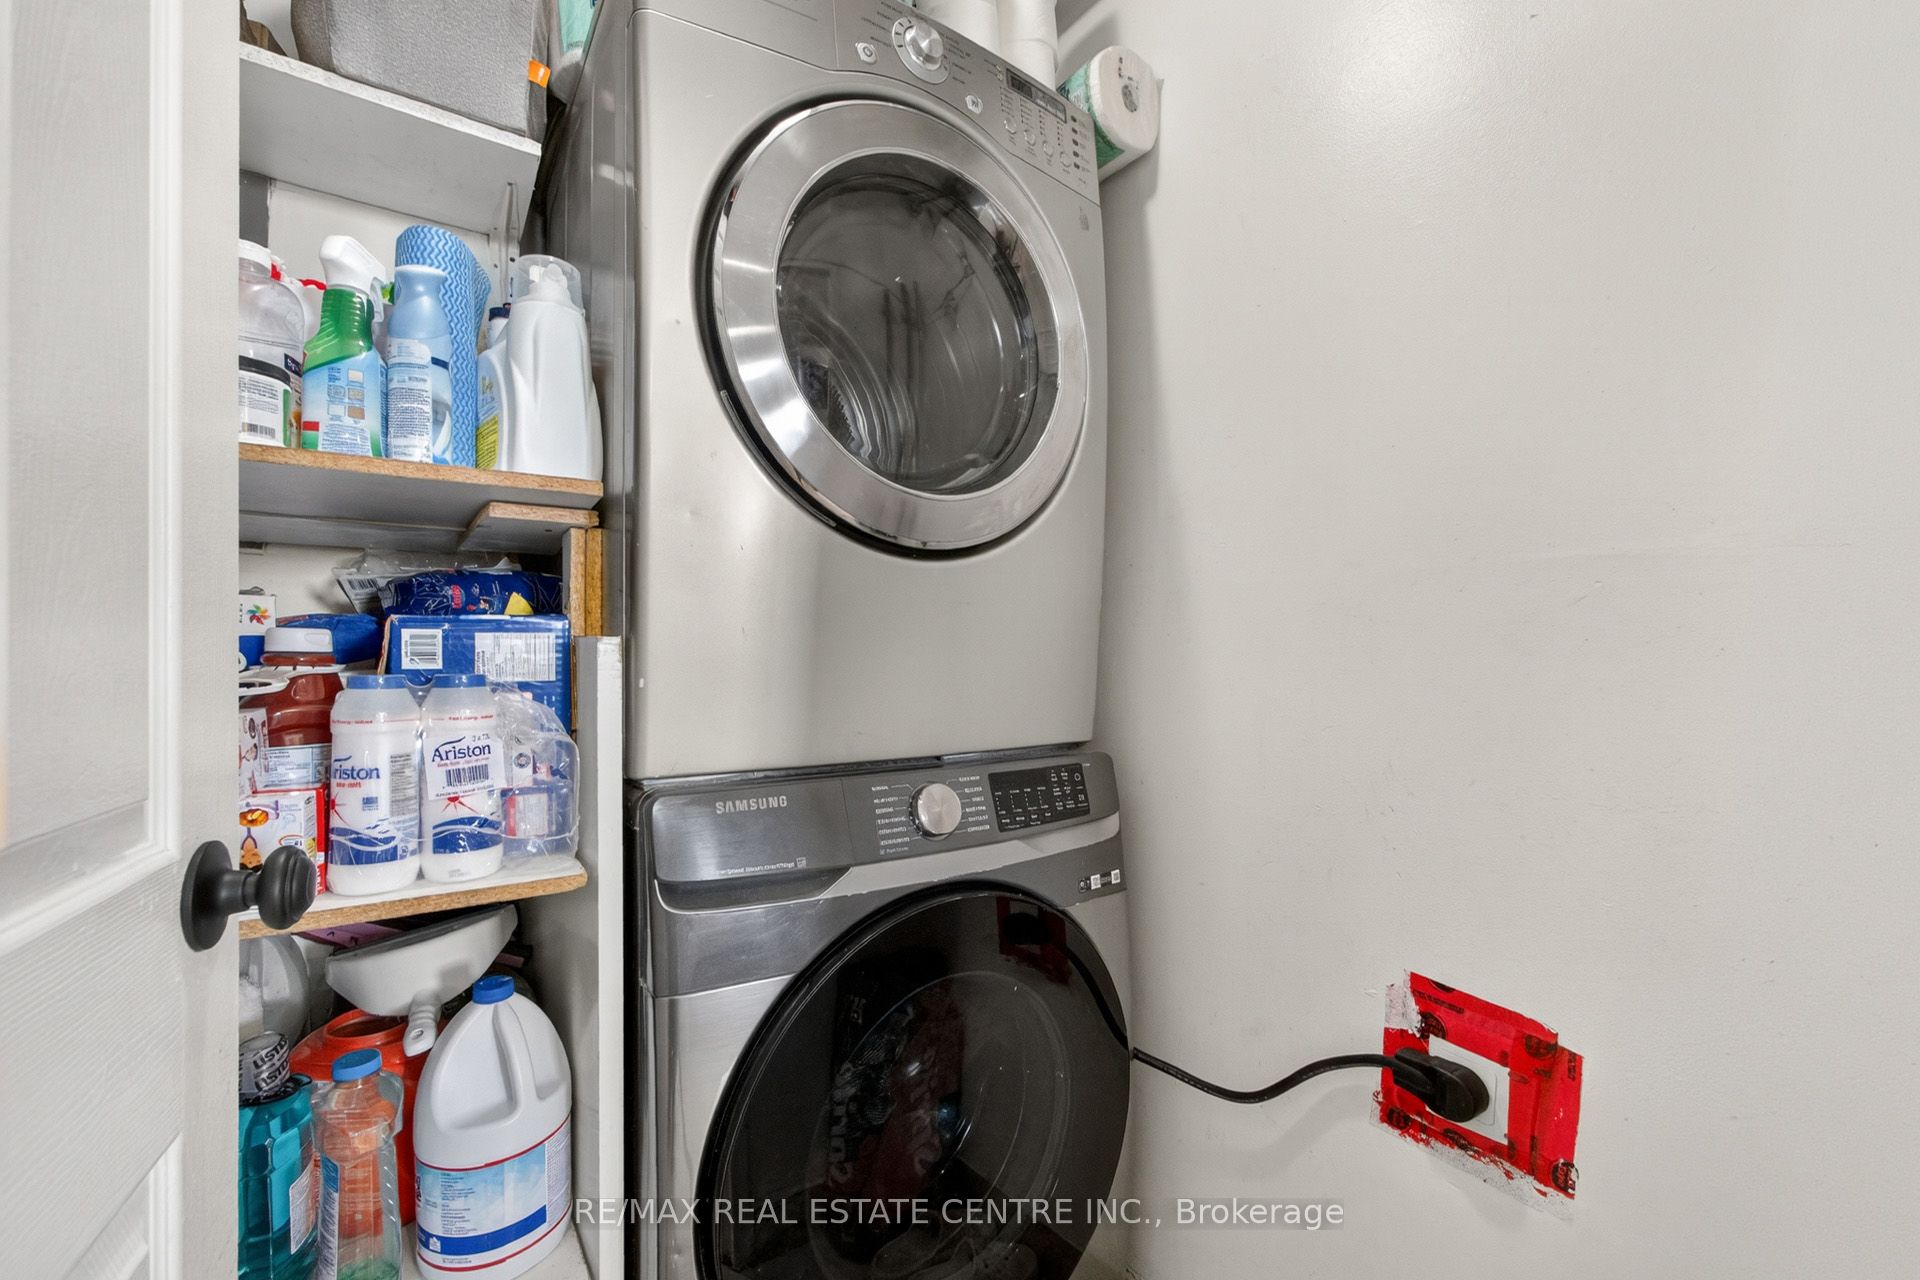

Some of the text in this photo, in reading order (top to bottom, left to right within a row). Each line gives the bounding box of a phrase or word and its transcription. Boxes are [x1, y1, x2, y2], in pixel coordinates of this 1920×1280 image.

[432, 736, 491, 762] Ariston
[333, 755, 380, 780] riston
[715, 795, 788, 814] SAMSUNG
